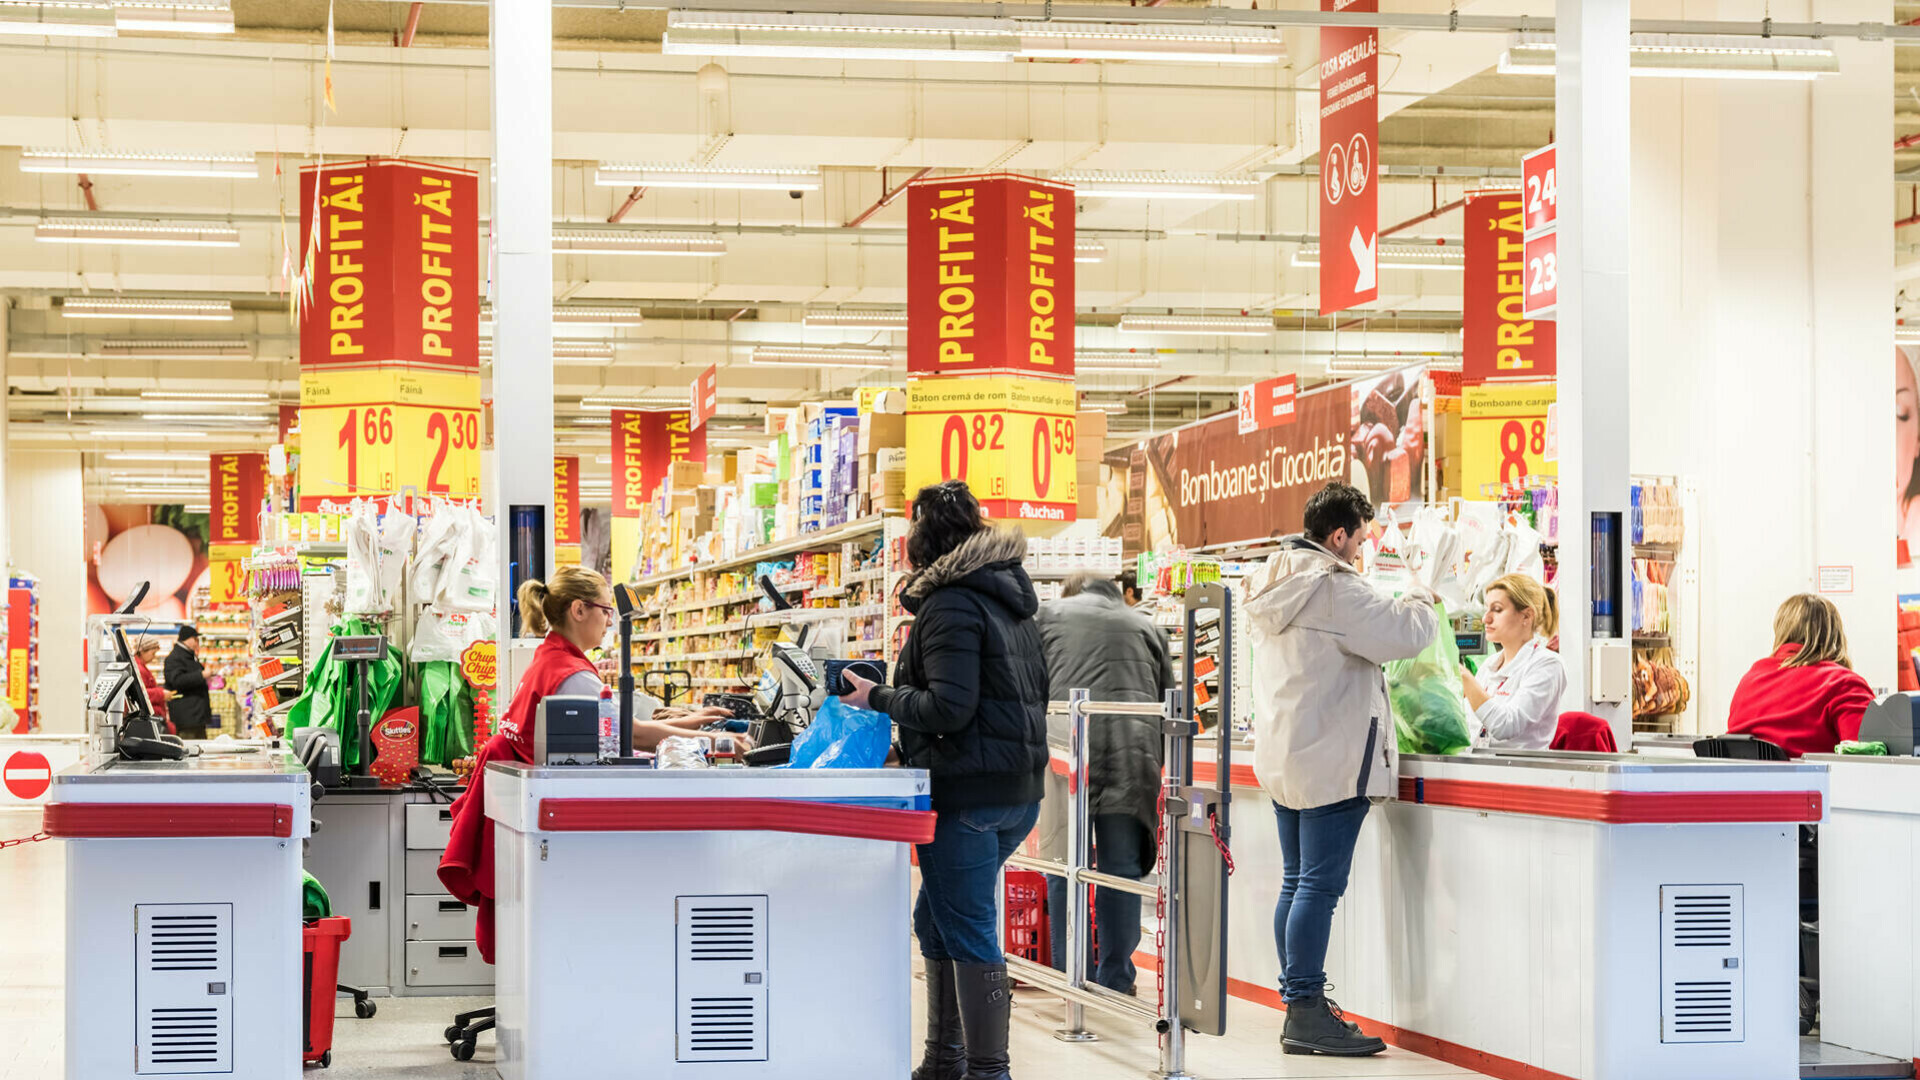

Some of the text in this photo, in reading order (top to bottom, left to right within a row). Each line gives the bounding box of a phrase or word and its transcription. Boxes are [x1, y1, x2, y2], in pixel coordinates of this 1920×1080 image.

[1527, 168, 1556, 214] 24
[321, 175, 364, 355] PROFITĂ!
[414, 176, 452, 357] PROFITĂ!
[930, 188, 975, 364] PROFITĂ!
[1023, 190, 1055, 366] PROFITĂ!
[1529, 252, 1556, 296] 23
[911, 390, 1007, 402] Baton cremă de rom
[1011, 392, 1030, 402] Baton
[1469, 399, 1523, 408] Bomboane
[620, 413, 642, 510] PROFITĂ!
[1180, 432, 1346, 507] Bomboane și Ciocolată
[219, 455, 239, 538] PROFITĂ!
[991, 477, 1005, 496] LEI
[1019, 502, 1064, 520] Auchan
[468, 650, 496, 664] Chup
